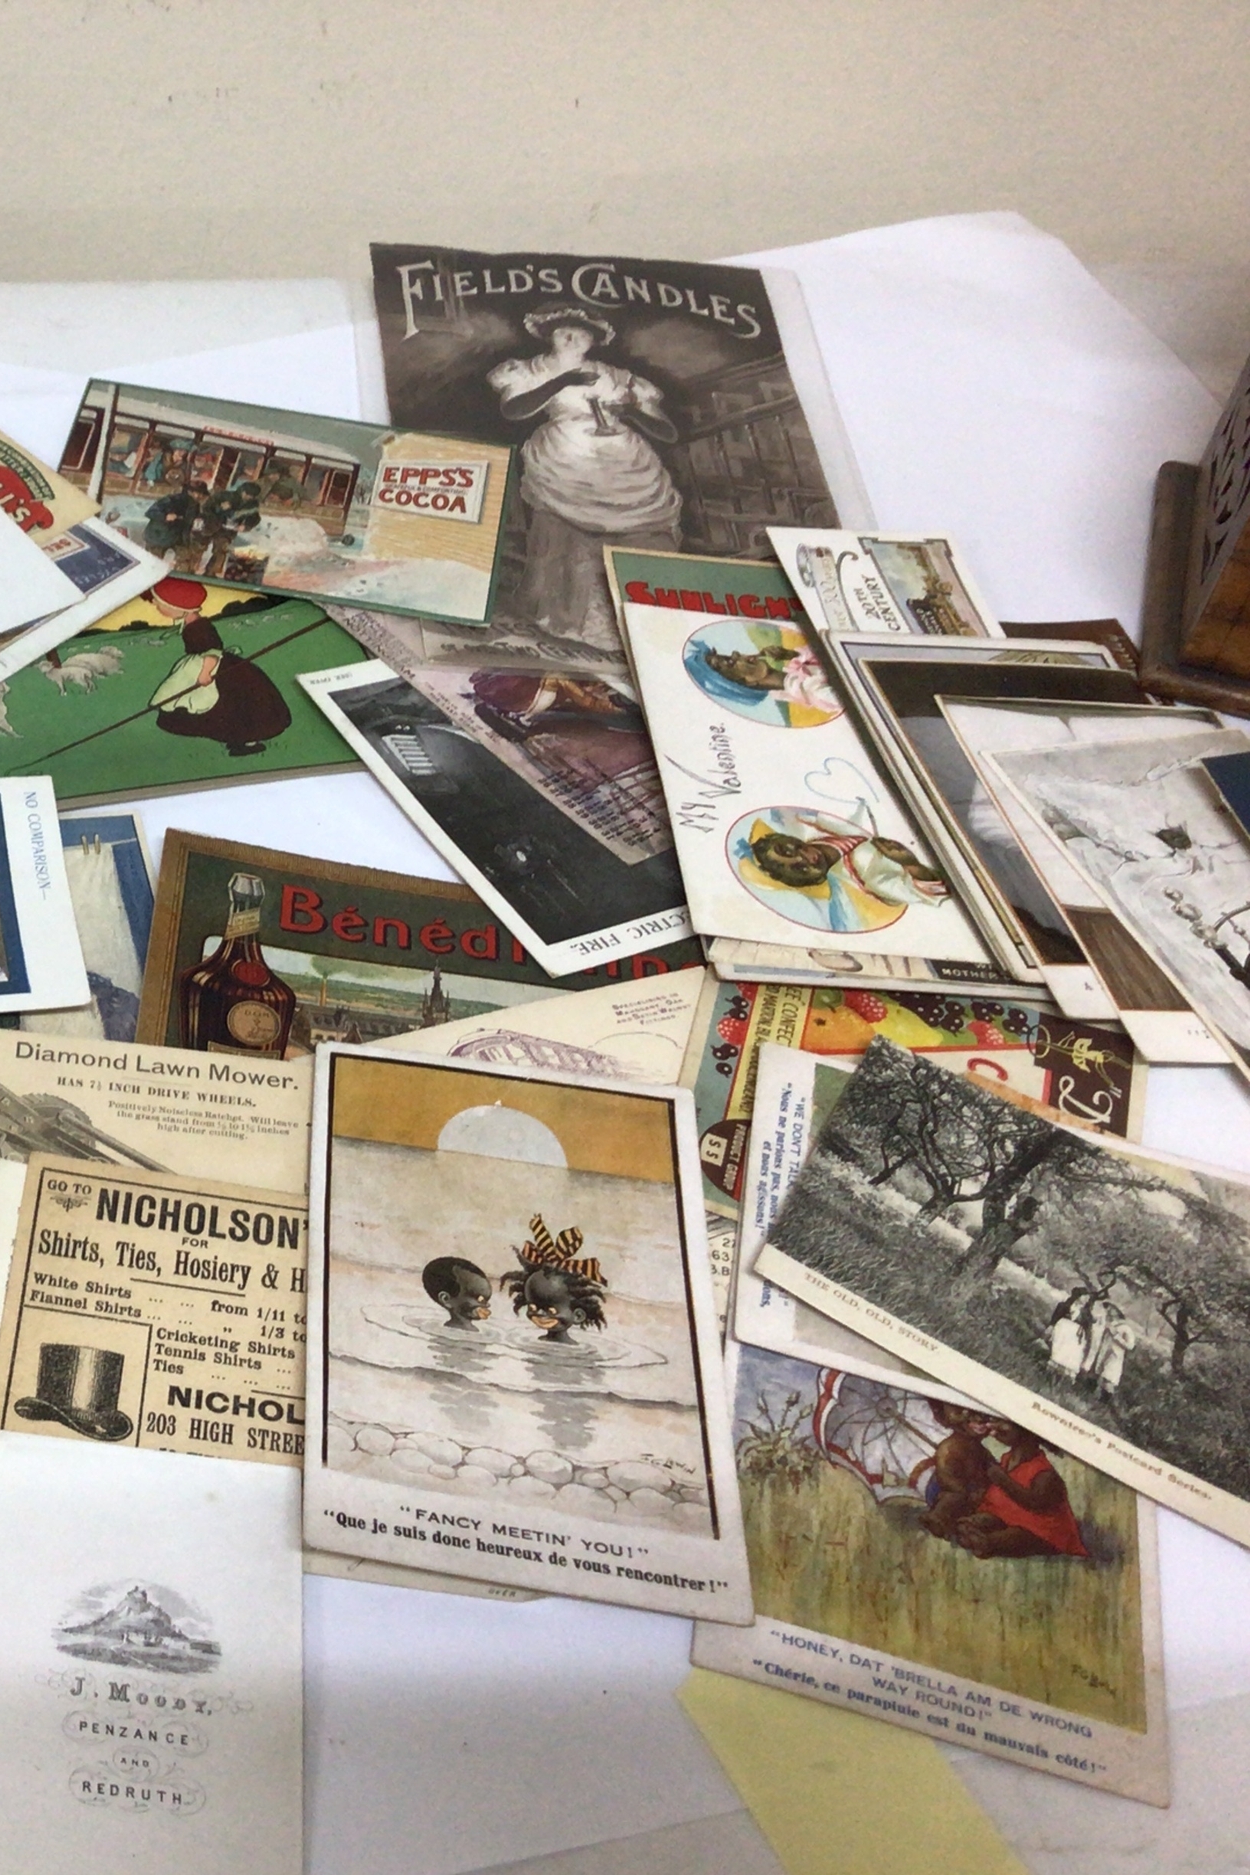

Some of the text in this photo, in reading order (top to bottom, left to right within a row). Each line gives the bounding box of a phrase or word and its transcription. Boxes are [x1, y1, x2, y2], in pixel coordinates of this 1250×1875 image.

[398, 261, 761, 340] FIELD'S CANDLES
[382, 466, 474, 488] EPPS'S
[378, 490, 467, 513] COCOA
[23, 791, 37, 808] NO
[15, 1041, 299, 1090] Diamond Lawn Mower.
[57, 1076, 257, 1108] HAS INCH DRIVE WHEELS.
[47, 1179, 309, 1250] GO TO NICHOLSON'
[181, 1237, 209, 1249] FOR
[38, 1228, 105, 1268] Shirts,
[115, 1241, 162, 1277] Ties,
[173, 1250, 253, 1291] Hosiery
[260, 1263, 280, 1290] &
[804, 1272, 831, 1289] THE
[33, 1272, 285, 1322] White Shirts from 1/11
[29, 1289, 285, 1339] Flannel Shirts 1/3
[154, 1343, 262, 1370] Tennis Shirts
[156, 1327, 295, 1360] Cricketing Shirts
[152, 1359, 185, 1375] Ties
[146, 1411, 235, 1445] 203 HIGH
[371, 1517, 611, 1576] je suis donc heureux de vous
[492, 1523, 572, 1546] MEETIN'
[850, 1653, 1093, 1739] DAT 'BRELLA AM DE WRONG
[872, 1677, 909, 1696] WAY
[79, 1720, 190, 1747] PENZANCE
[824, 1681, 1050, 1759] ce parapluie est du mauvais
[120, 1756, 150, 1769] AND
[83, 1780, 183, 1806] REDRUTH
